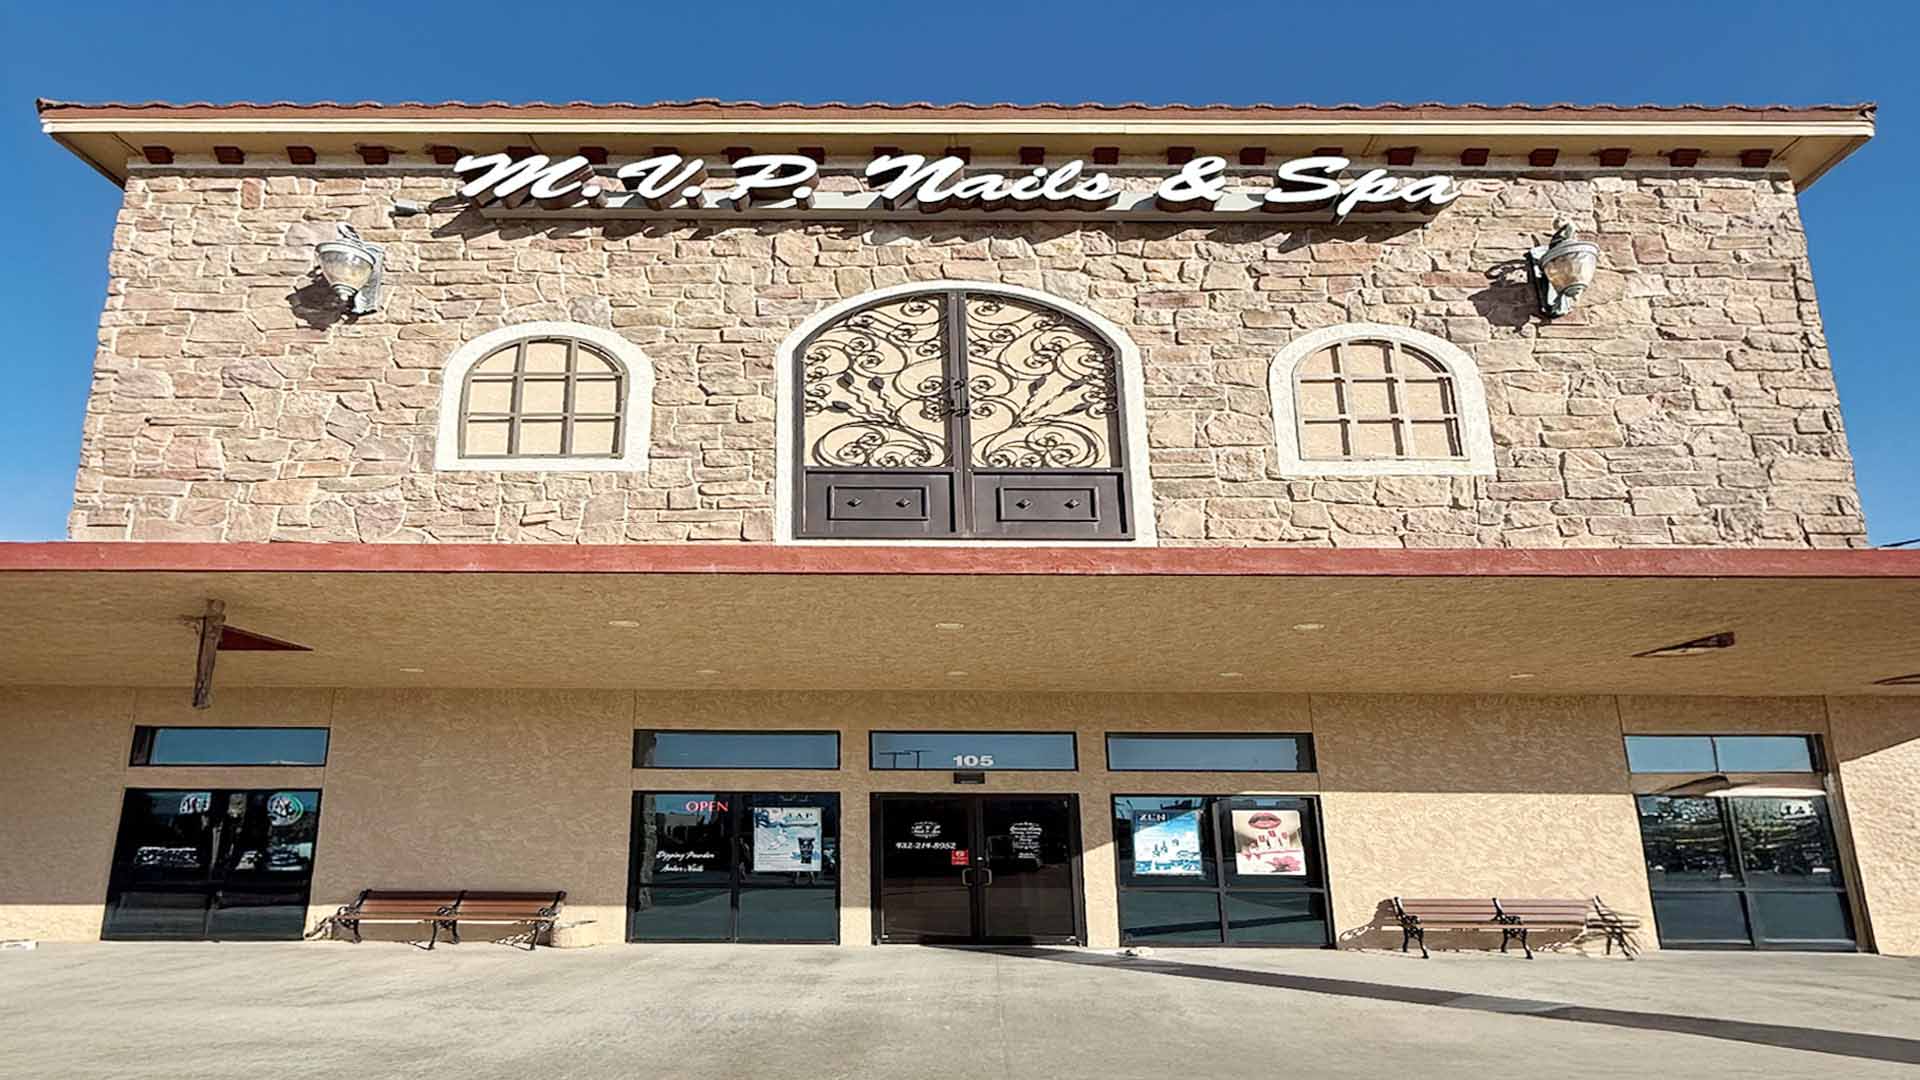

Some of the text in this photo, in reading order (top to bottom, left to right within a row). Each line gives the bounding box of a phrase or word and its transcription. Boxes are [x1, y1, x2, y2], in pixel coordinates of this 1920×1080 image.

[865, 155, 1121, 202] Nails
[1158, 157, 1226, 201] &
[1265, 156, 1461, 216] Spa
[953, 754, 994, 767] 105
[685, 800, 729, 813] OPEN
